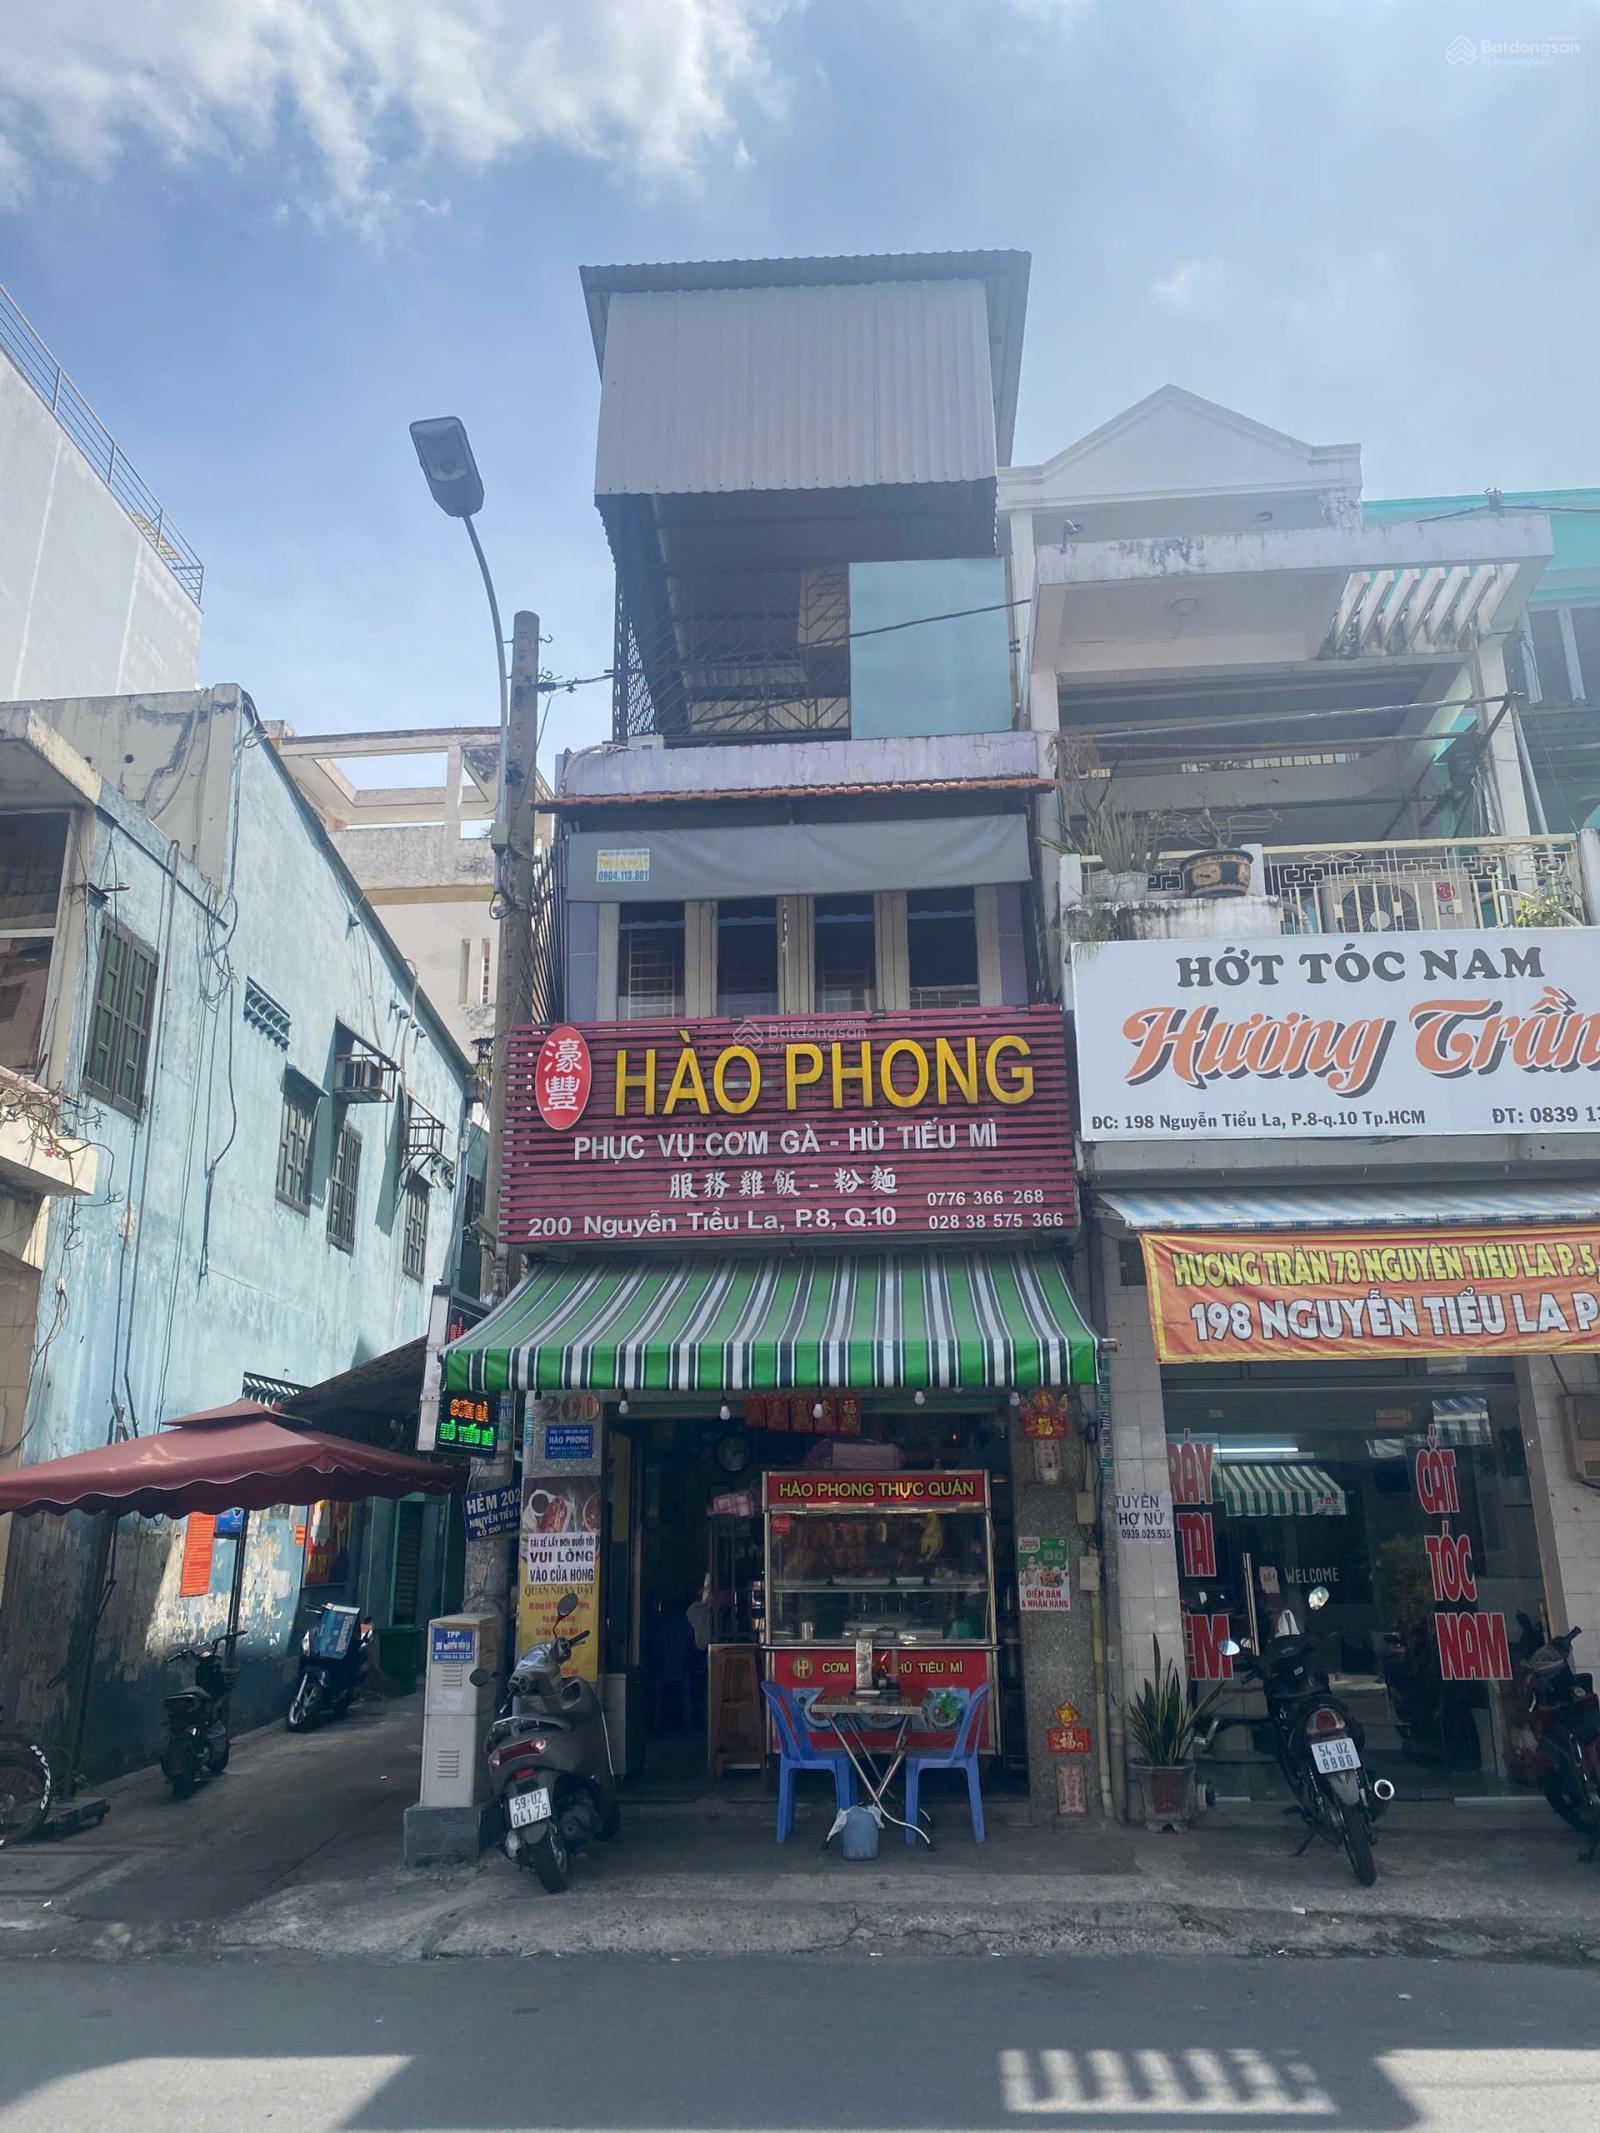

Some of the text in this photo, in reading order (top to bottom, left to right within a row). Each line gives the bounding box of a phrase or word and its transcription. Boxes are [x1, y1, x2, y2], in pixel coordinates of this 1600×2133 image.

[1438, 904, 1455, 915] LG
[1176, 943, 1545, 987] HỚT TÓC NAM
[1122, 985, 1600, 1099] Hương Trần
[615, 1029, 1035, 1117] HÀO PHONG
[1092, 1110, 1426, 1131] ĐC: 198 Nguyễn Tiểu La, P.8-q.10 Tp.HCM
[1492, 1107, 1524, 1124] ĐT:
[1530, 1106, 1578, 1123] 0839
[574, 1134, 645, 1165] PHỤC
[657, 1132, 695, 1162] VỤ
[705, 1130, 768, 1157] CƠM
[780, 1123, 821, 1154] GÀ
[849, 1120, 885, 1151] HỦ
[897, 1117, 956, 1149] TIẾU
[969, 1118, 998, 1148] MÌ
[927, 1189, 1044, 1206] 0776 366 268
[528, 1206, 897, 1239] 200 Nguyễn Tiểu La, P.8, Q.10
[928, 1212, 1064, 1230] 028 38 575 366
[1330, 1250, 1362, 1284] 78
[1518, 1243, 1558, 1278] LA
[1190, 1301, 1253, 1342] 198
[1257, 1287, 1420, 1341] NGUYỄN
[1421, 1285, 1507, 1337] TIỂU
[1510, 1292, 1572, 1334] LA
[1415, 1423, 1461, 1513] CẮT
[779, 1479, 975, 1500] HÀO PHONG THỰC QUÁN
[1143, 1508, 1166, 1526] NỮ
[529, 1548, 594, 1563] VUI LÒNG
[1176, 1511, 1217, 1578] TAI
[529, 1566, 548, 1582] VÀO
[1424, 1520, 1478, 1602] TÓC
[1283, 1566, 1341, 1584] WELCOME
[1434, 1612, 1513, 1681] NAM
[822, 1661, 850, 1674] CƠM
